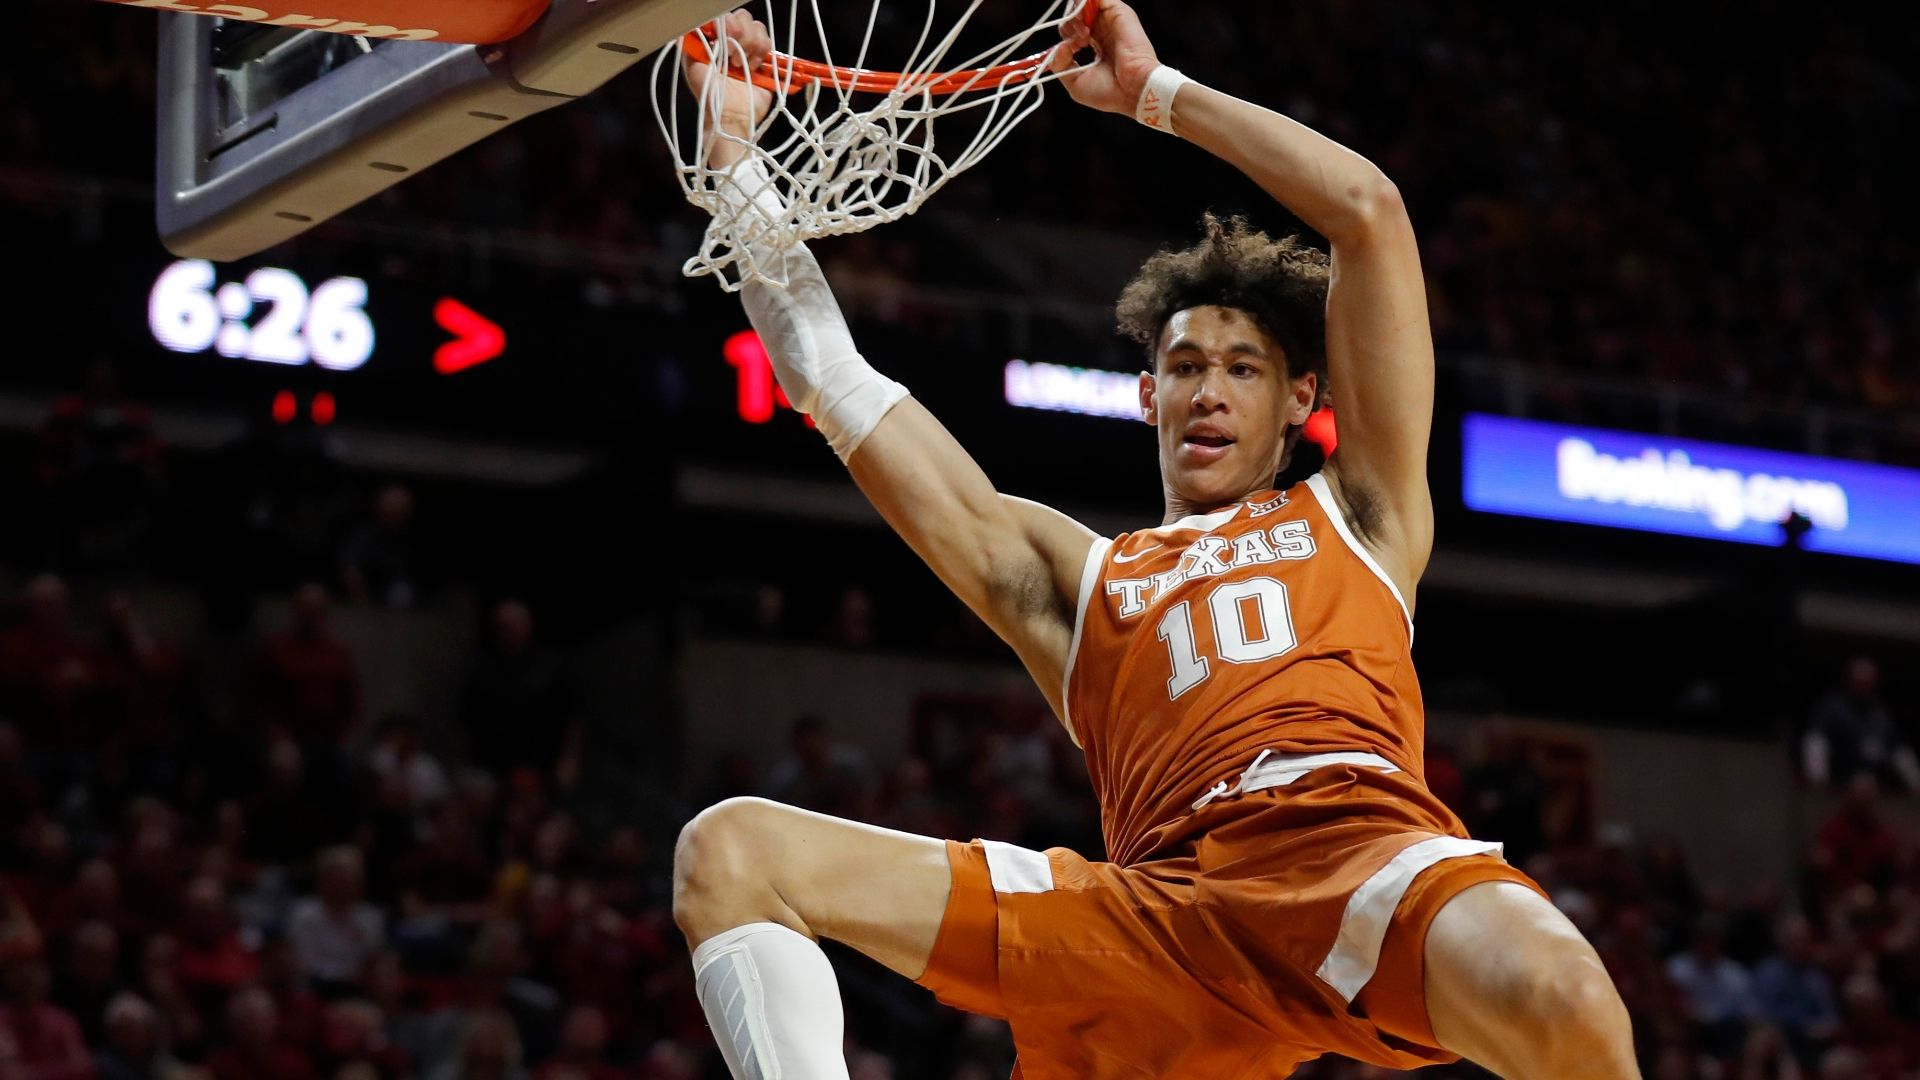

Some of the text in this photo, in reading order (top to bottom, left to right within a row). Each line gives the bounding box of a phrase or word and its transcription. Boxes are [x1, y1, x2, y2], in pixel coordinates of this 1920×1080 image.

[148, 257, 375, 371] 6:26
[1106, 519, 1319, 620] TEXAS
[1156, 576, 1299, 702] 10
